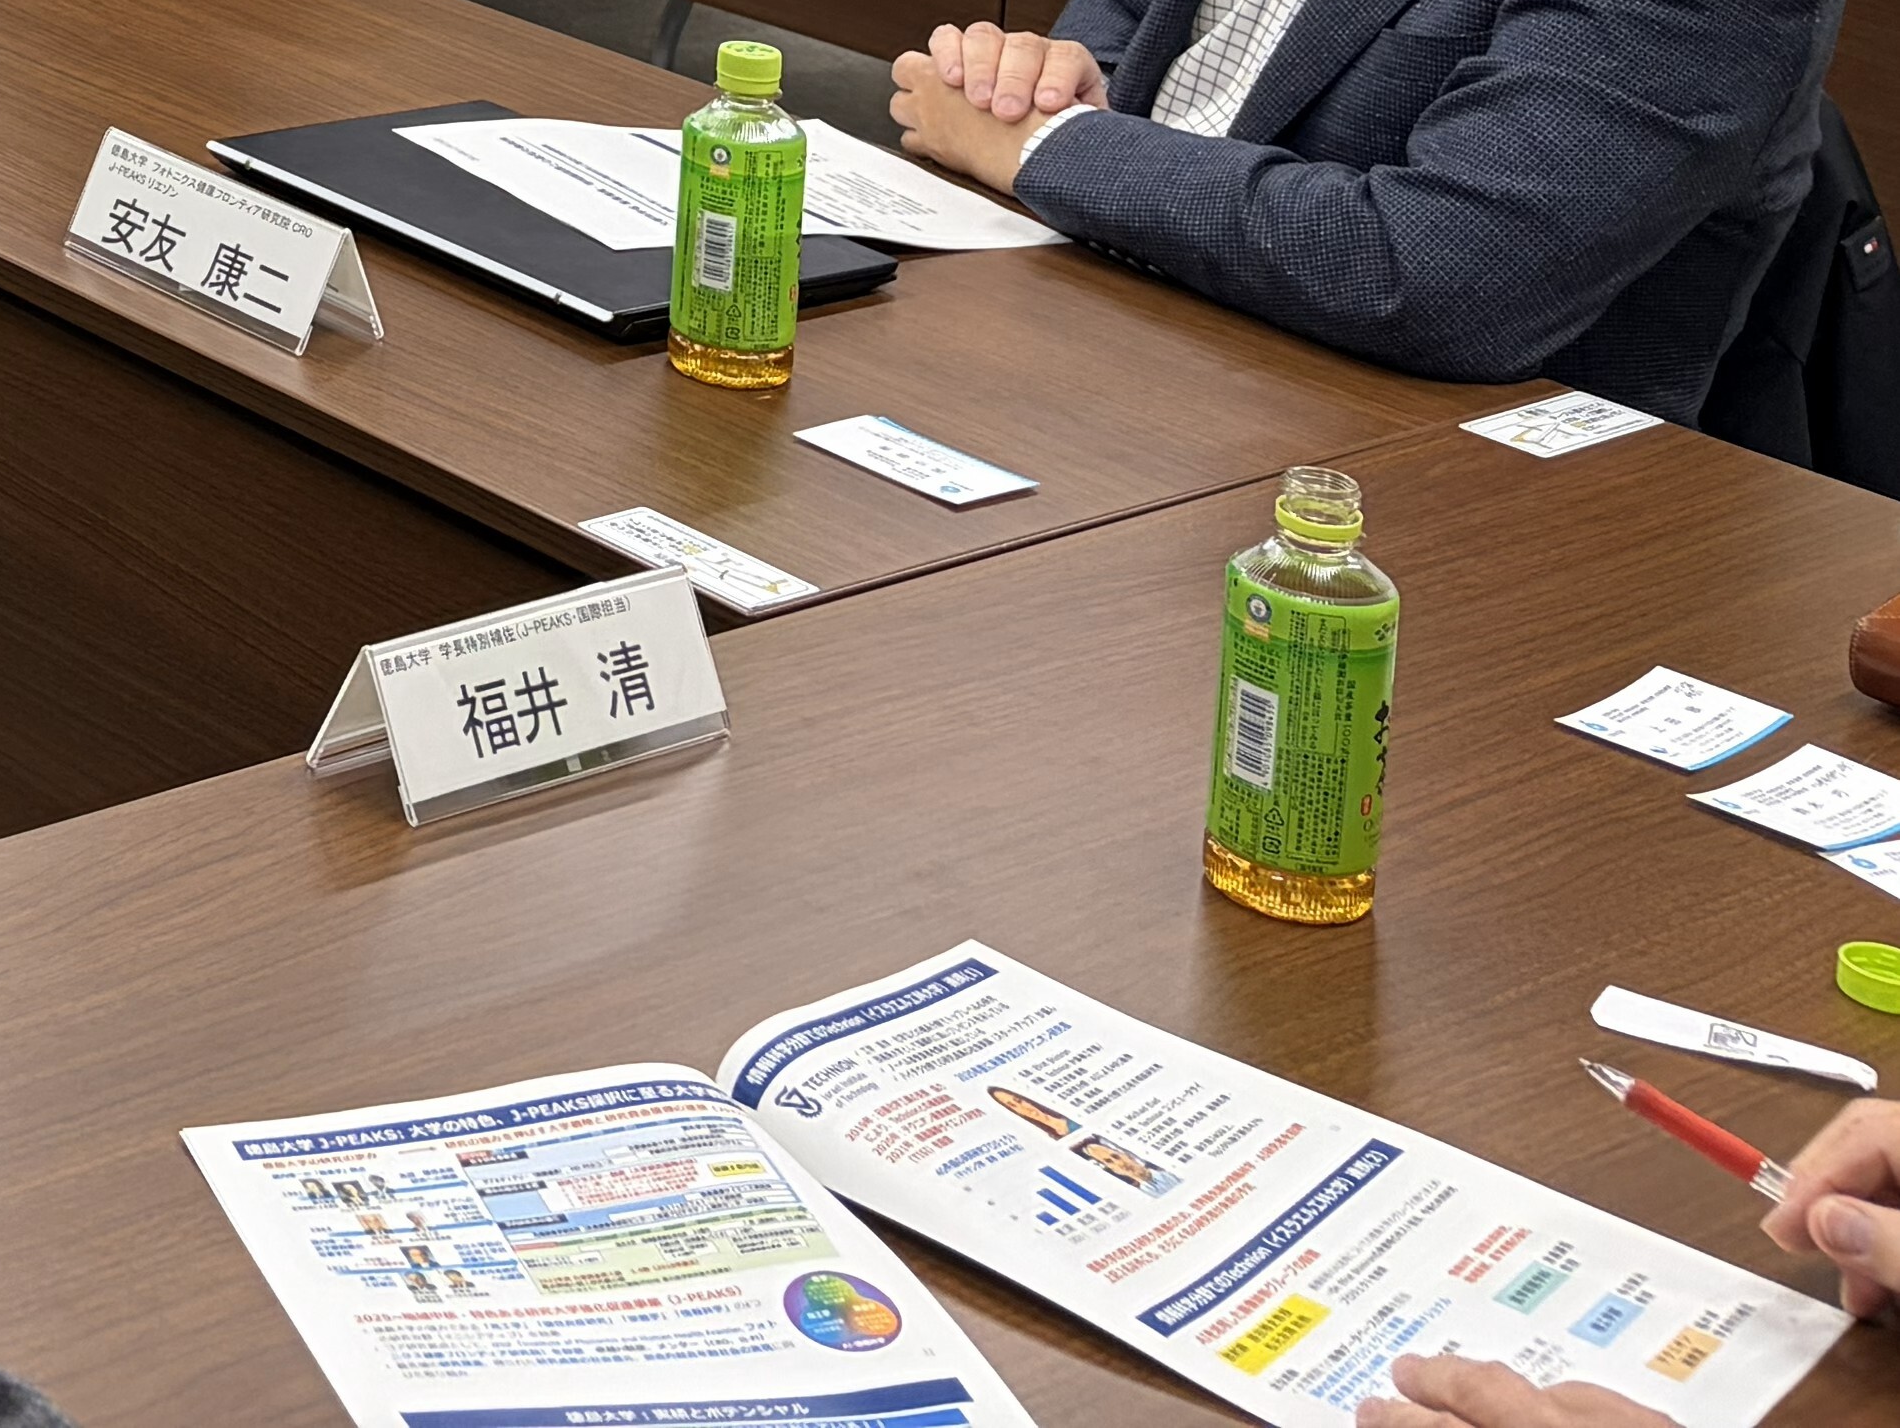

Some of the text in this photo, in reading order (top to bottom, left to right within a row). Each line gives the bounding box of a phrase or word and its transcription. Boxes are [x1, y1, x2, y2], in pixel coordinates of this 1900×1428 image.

[111, 144, 148, 168] 徳島大学
[101, 198, 289, 314] 安友 康二
[456, 640, 656, 758] 福井 清
[803, 1056, 857, 1094] TECHNION
